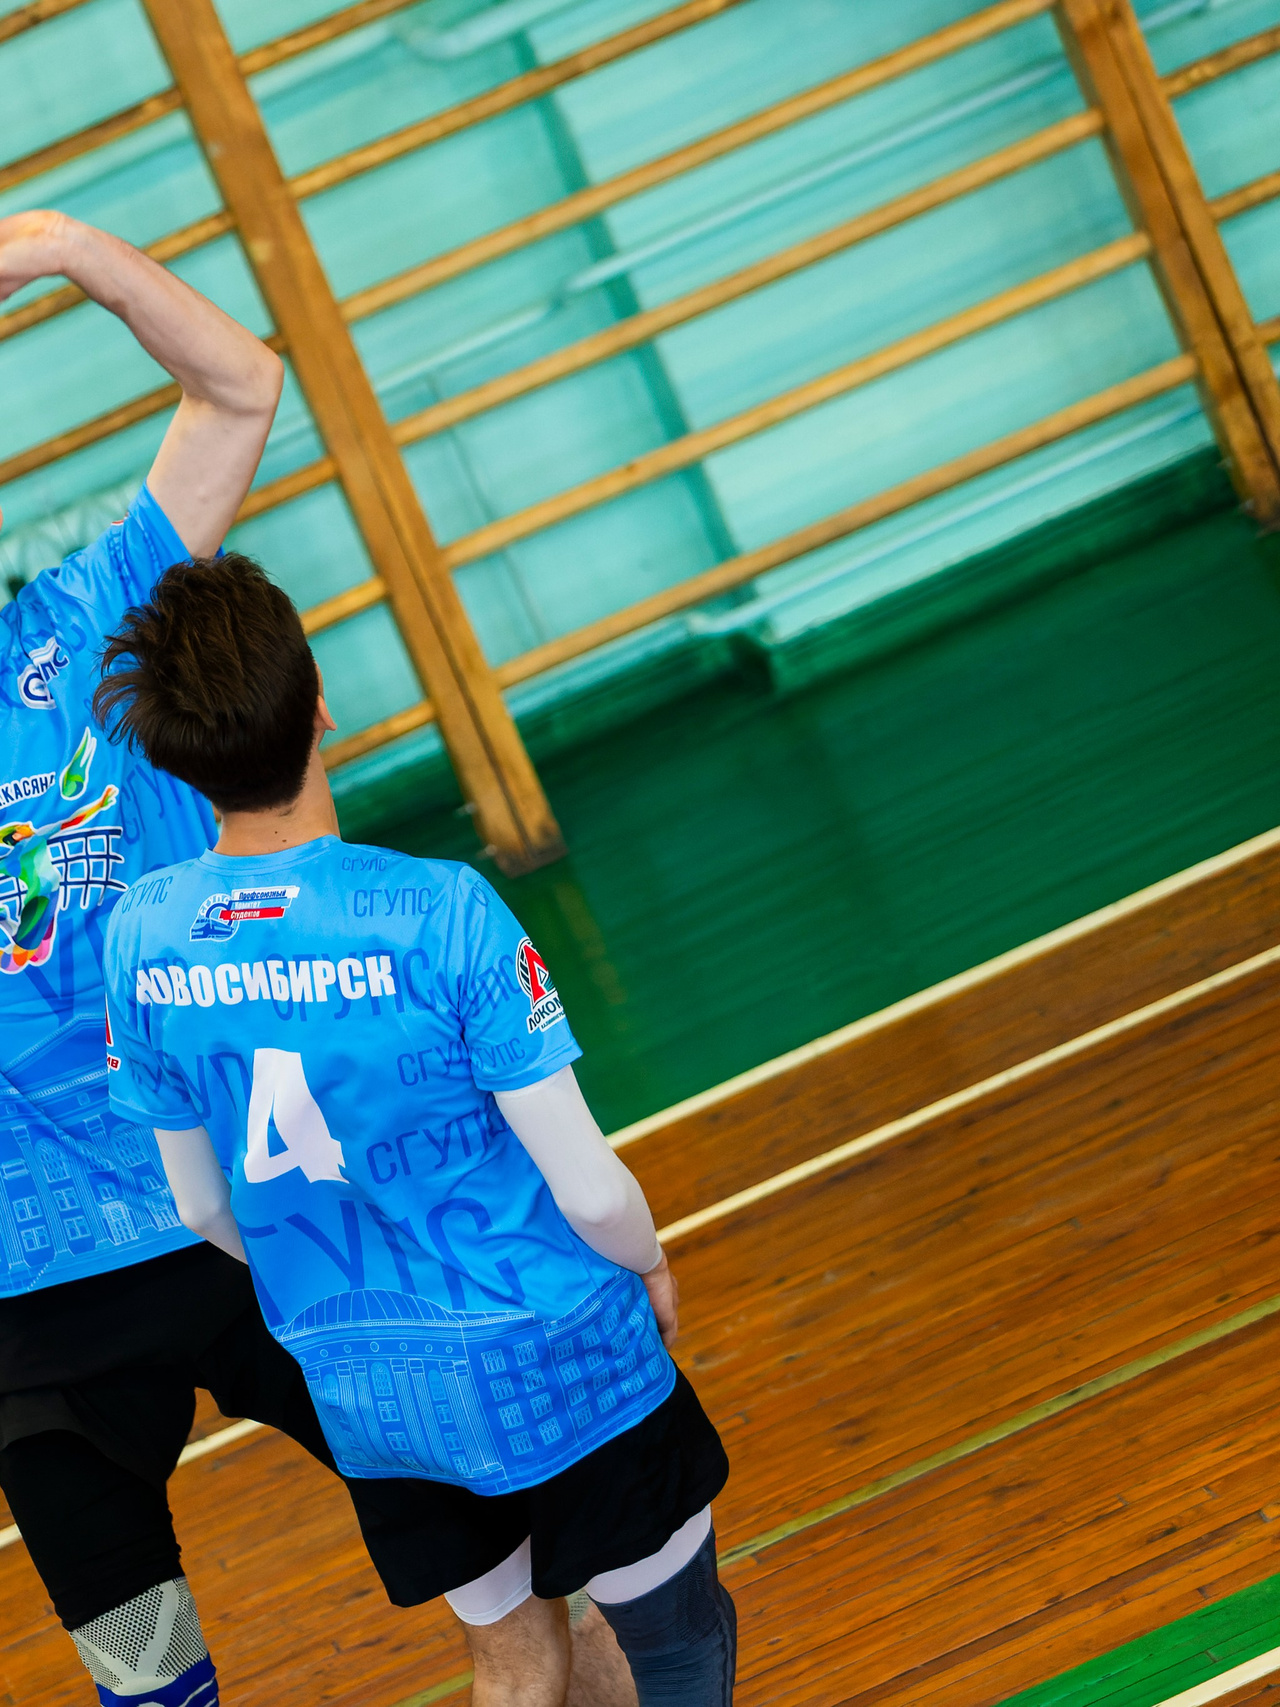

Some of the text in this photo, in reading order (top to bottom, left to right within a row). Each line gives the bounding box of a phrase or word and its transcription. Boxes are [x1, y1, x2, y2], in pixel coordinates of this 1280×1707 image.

[342, 857, 395, 872] СГУПС
[122, 875, 174, 914] СГУПС
[353, 887, 432, 918] СГУПС
[244, 1048, 349, 1184] 4
